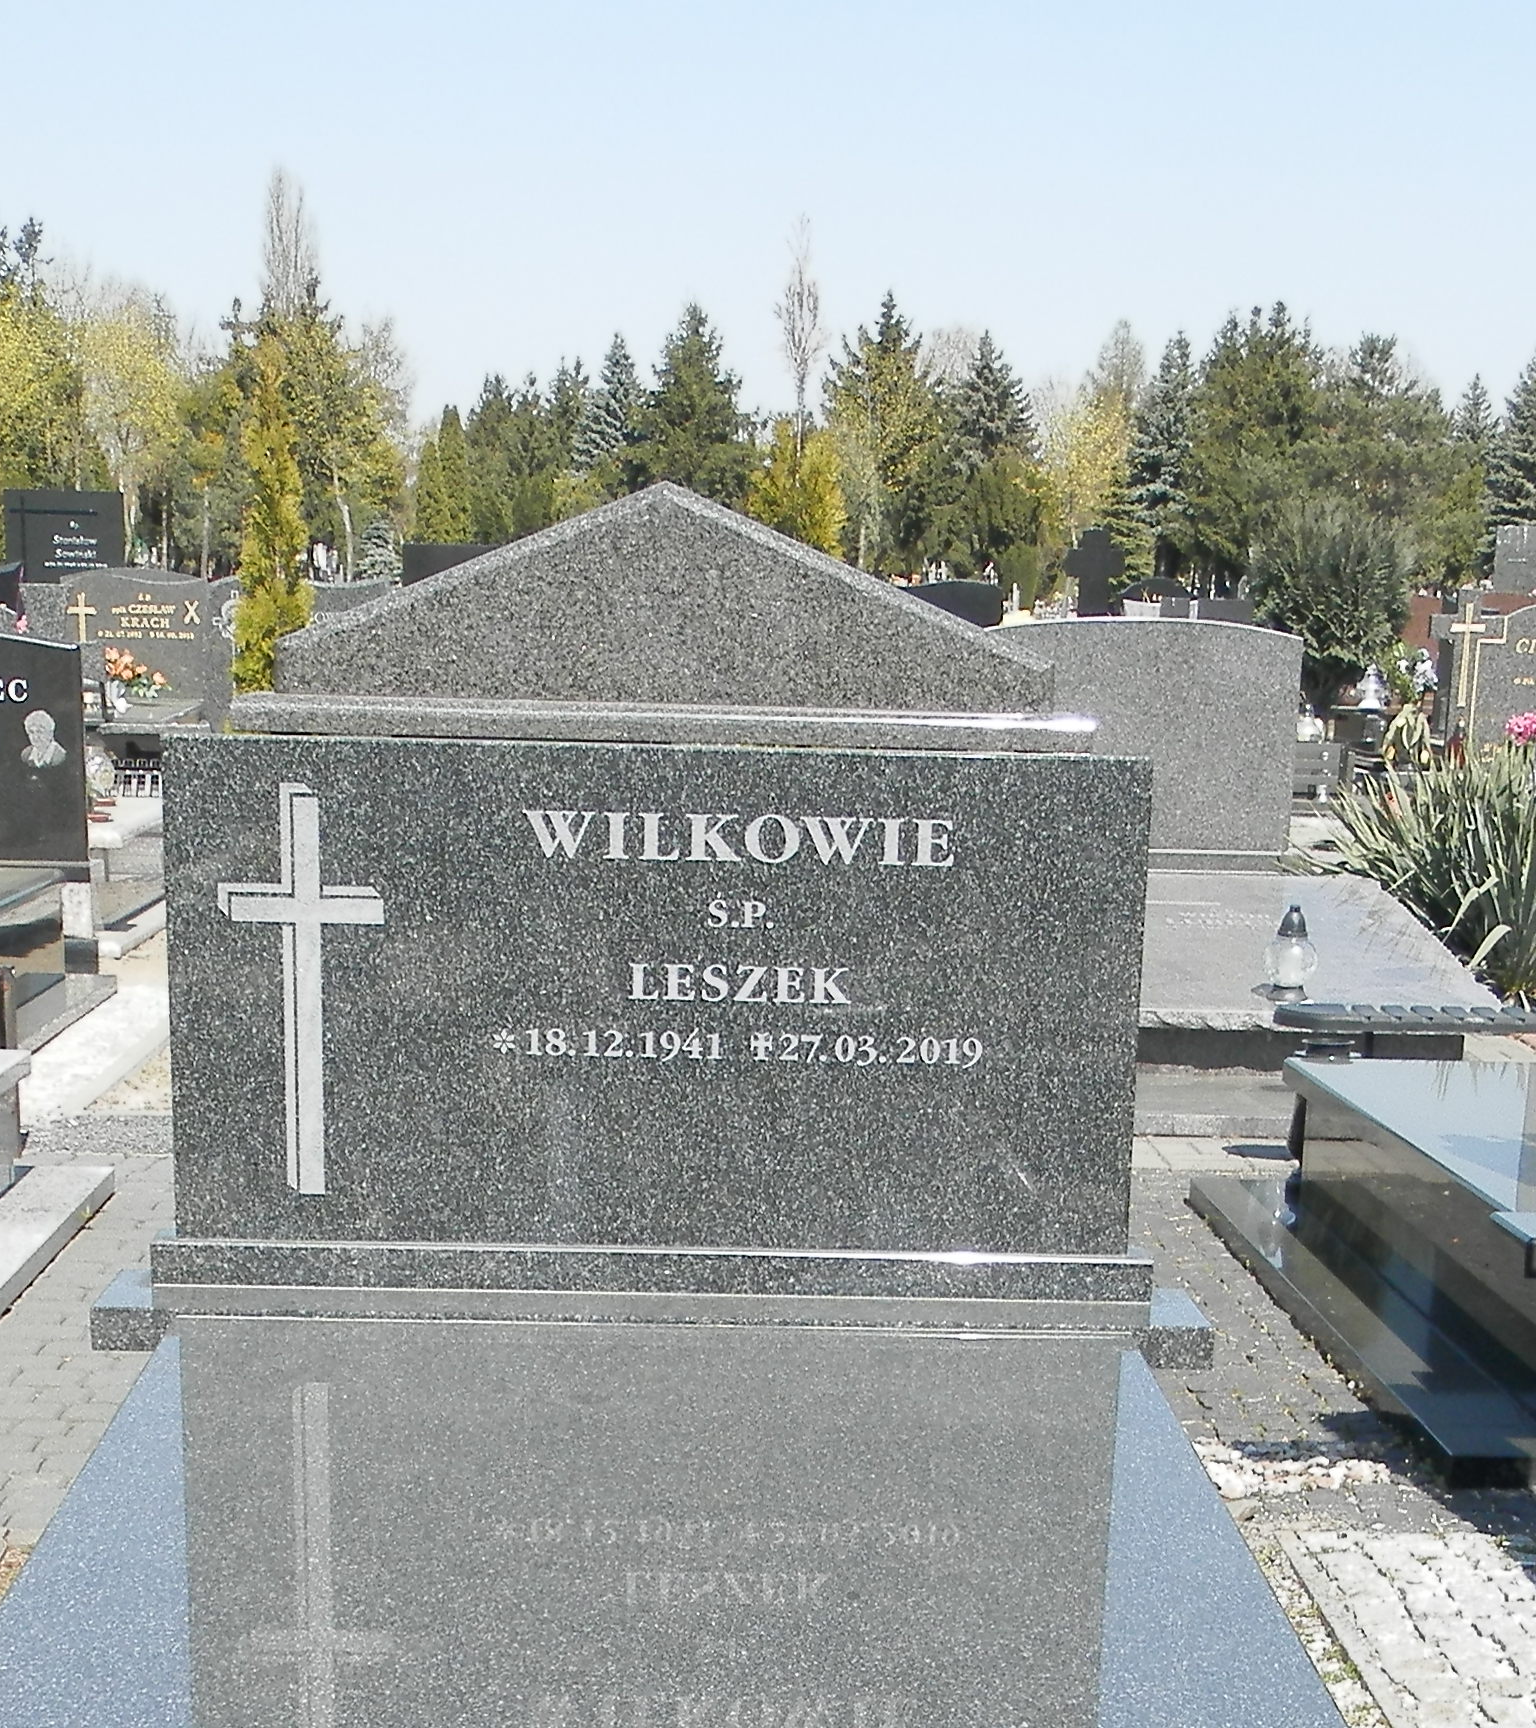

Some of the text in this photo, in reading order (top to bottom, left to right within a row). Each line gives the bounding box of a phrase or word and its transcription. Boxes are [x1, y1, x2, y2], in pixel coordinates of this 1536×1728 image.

[120, 616, 171, 629] KRACH
[523, 810, 957, 868] WILKOWIE
[627, 962, 853, 1005] LESZEK
[523, 1028, 985, 1069] 18.12.1941 27.03.2019
